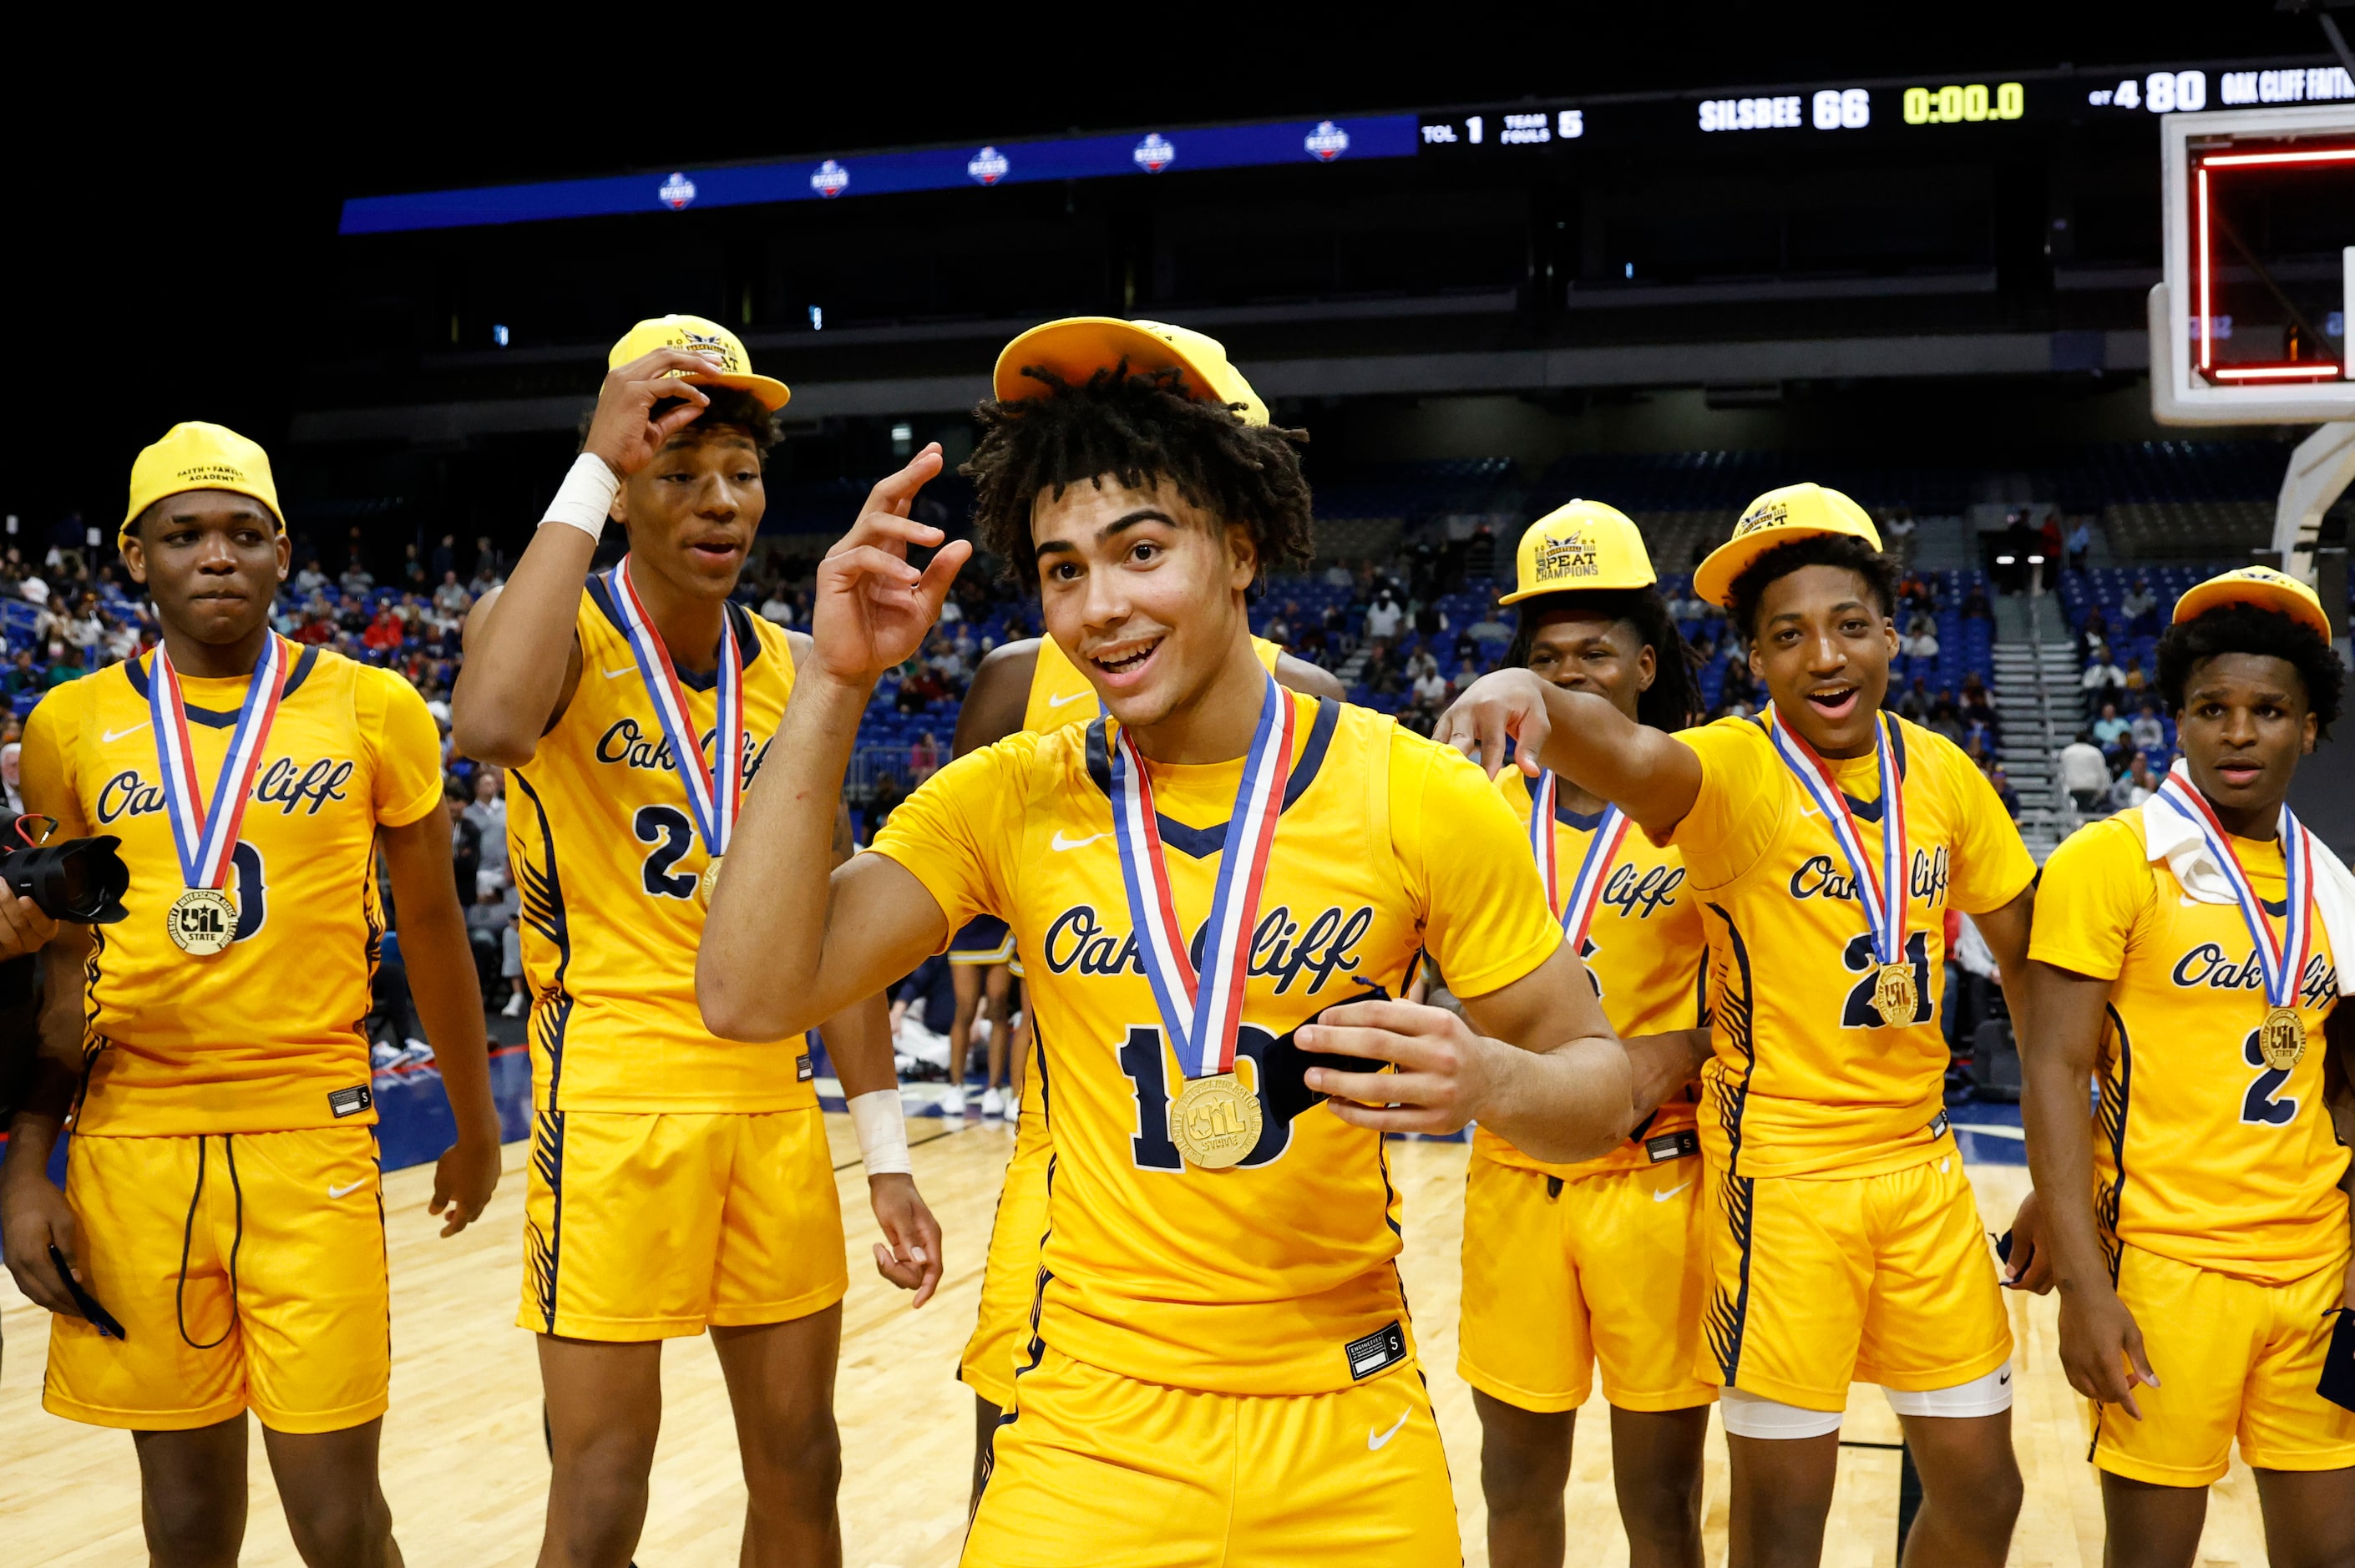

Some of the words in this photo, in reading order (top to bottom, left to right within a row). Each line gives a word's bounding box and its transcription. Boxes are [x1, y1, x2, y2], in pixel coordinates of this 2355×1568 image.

[1903, 83, 2023, 124] 0:00.0
[2114, 80, 2141, 109] 4
[2145, 70, 2206, 113] 80
[2221, 71, 2259, 105] OAK
[2259, 69, 2307, 103] CLIFF
[1504, 114, 1547, 129] TEAM
[1558, 110, 1583, 138] 5
[1699, 96, 1801, 131] SILSBEE
[1813, 89, 1870, 129] 66
[1421, 125, 1457, 144] TOL
[1466, 116, 1483, 144] 1
[1501, 128, 1551, 144] FOULS
[177, 466, 205, 478] FAITH
[213, 466, 244, 478] FAMILY
[189, 473, 235, 482] ACADEMY
[1536, 564, 1598, 583] CHAMPIONS
[96, 770, 166, 825] Oa
[250, 756, 353, 815] liff
[1602, 862, 1687, 918] liff
[168, 908, 189, 949] UNIVERSITY
[1840, 929, 1934, 1029] 21
[2171, 942, 2265, 989] Oak
[2240, 1025, 2299, 1127] 2
[362, 1092, 368, 1103] S
[1201, 1135, 1238, 1152] STATE
[1684, 1138, 1691, 1149] S
[1390, 1336, 1399, 1351] S
